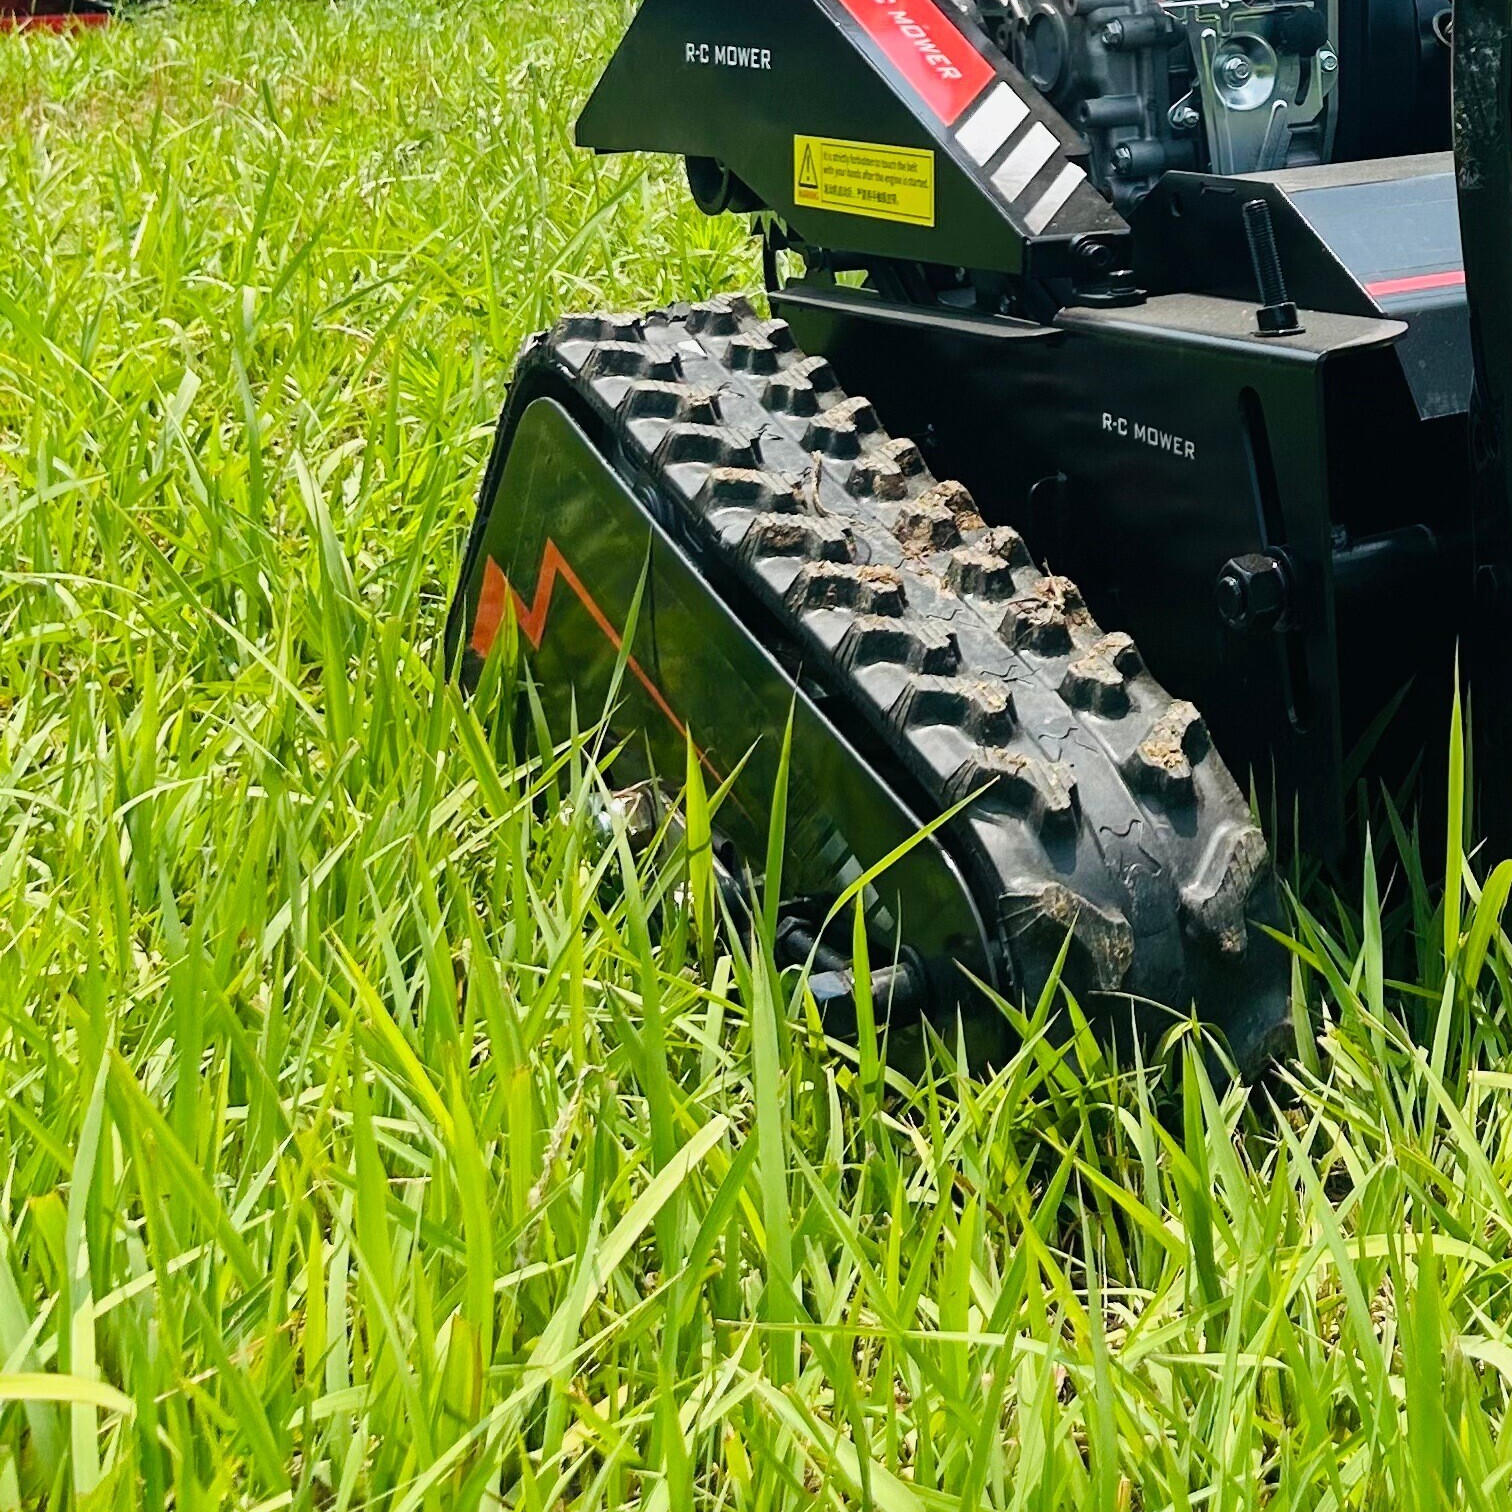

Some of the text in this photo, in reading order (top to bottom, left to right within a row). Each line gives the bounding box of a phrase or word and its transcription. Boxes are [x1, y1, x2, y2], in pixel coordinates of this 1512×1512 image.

[714, 45, 772, 70] MOWER
[888, 10, 963, 80] MOWER
[1134, 422, 1195, 460] MOWER
